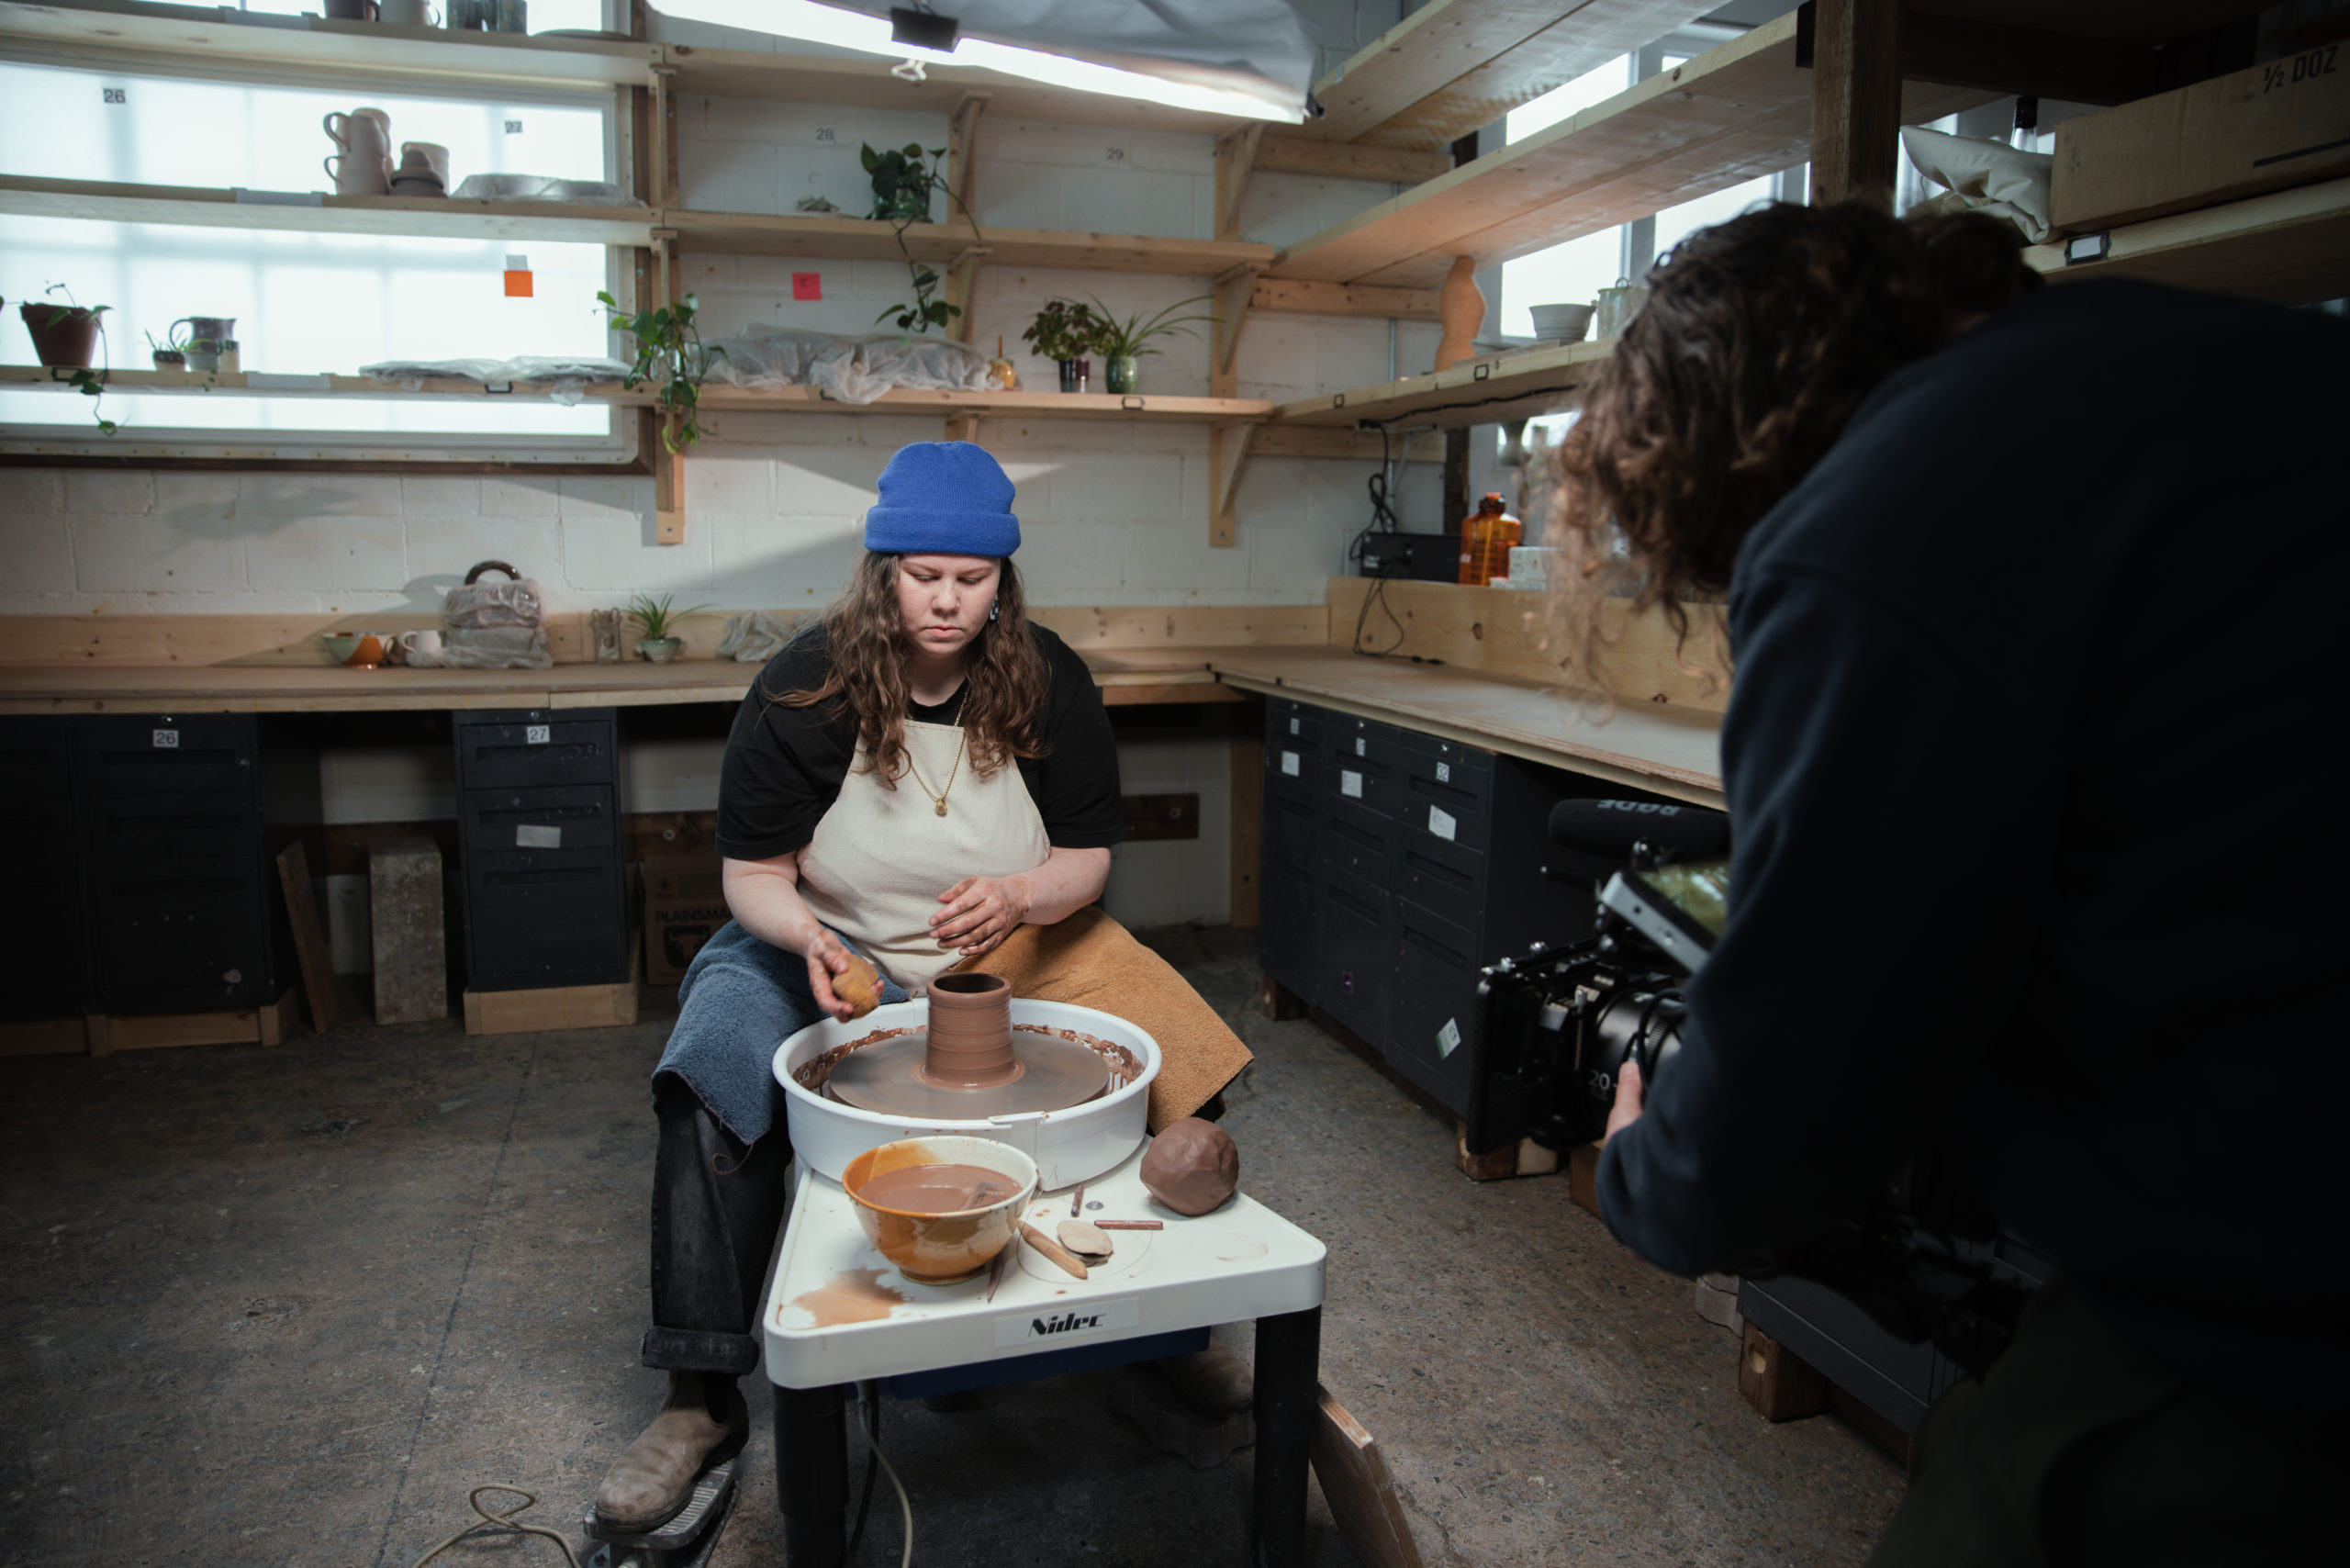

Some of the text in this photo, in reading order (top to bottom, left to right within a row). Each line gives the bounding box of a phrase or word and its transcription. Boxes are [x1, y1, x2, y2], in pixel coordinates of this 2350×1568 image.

[2292, 45, 2339, 84] DOZ
[103, 88, 126, 104] 26
[505, 121, 522, 134] 27
[815, 127, 834, 141] 28
[1106, 147, 1125, 161] 29
[156, 732, 176, 745] 26
[530, 728, 547, 742] 27
[655, 907, 733, 924] PLAINSMA
[1028, 1313, 1107, 1338] Nidec
